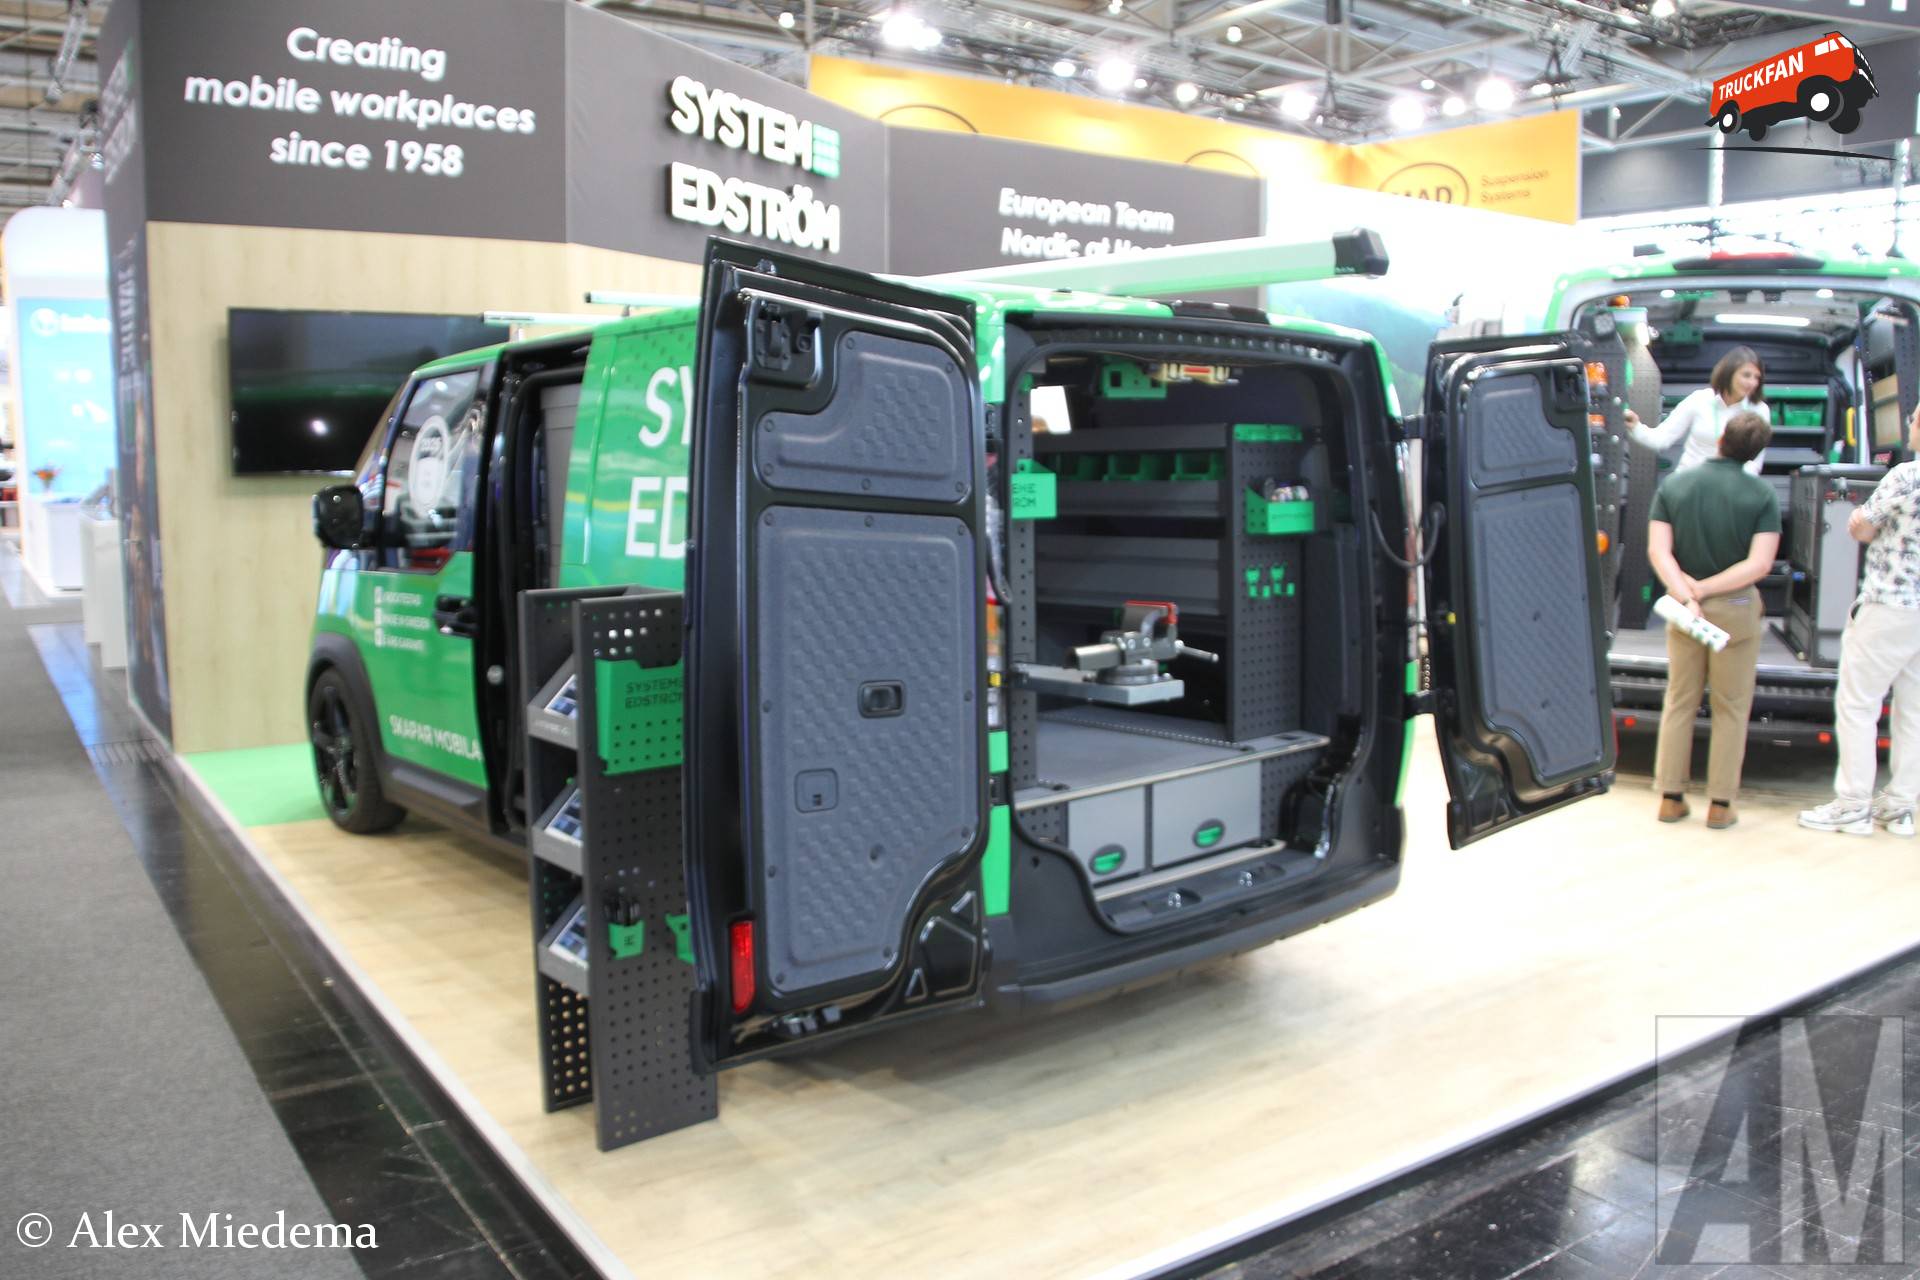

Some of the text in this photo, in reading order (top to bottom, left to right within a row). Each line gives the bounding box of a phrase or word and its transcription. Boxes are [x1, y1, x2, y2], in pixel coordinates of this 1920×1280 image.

[286, 27, 447, 82] Creating
[184, 75, 322, 114] mobile
[330, 86, 537, 135] workplaces
[671, 75, 813, 171] SYSTEM
[269, 131, 465, 178] since 1958
[671, 161, 841, 254] EDSTRÖM
[999, 187, 1175, 234] European Team
[1001, 227, 1082, 259] Nordic
